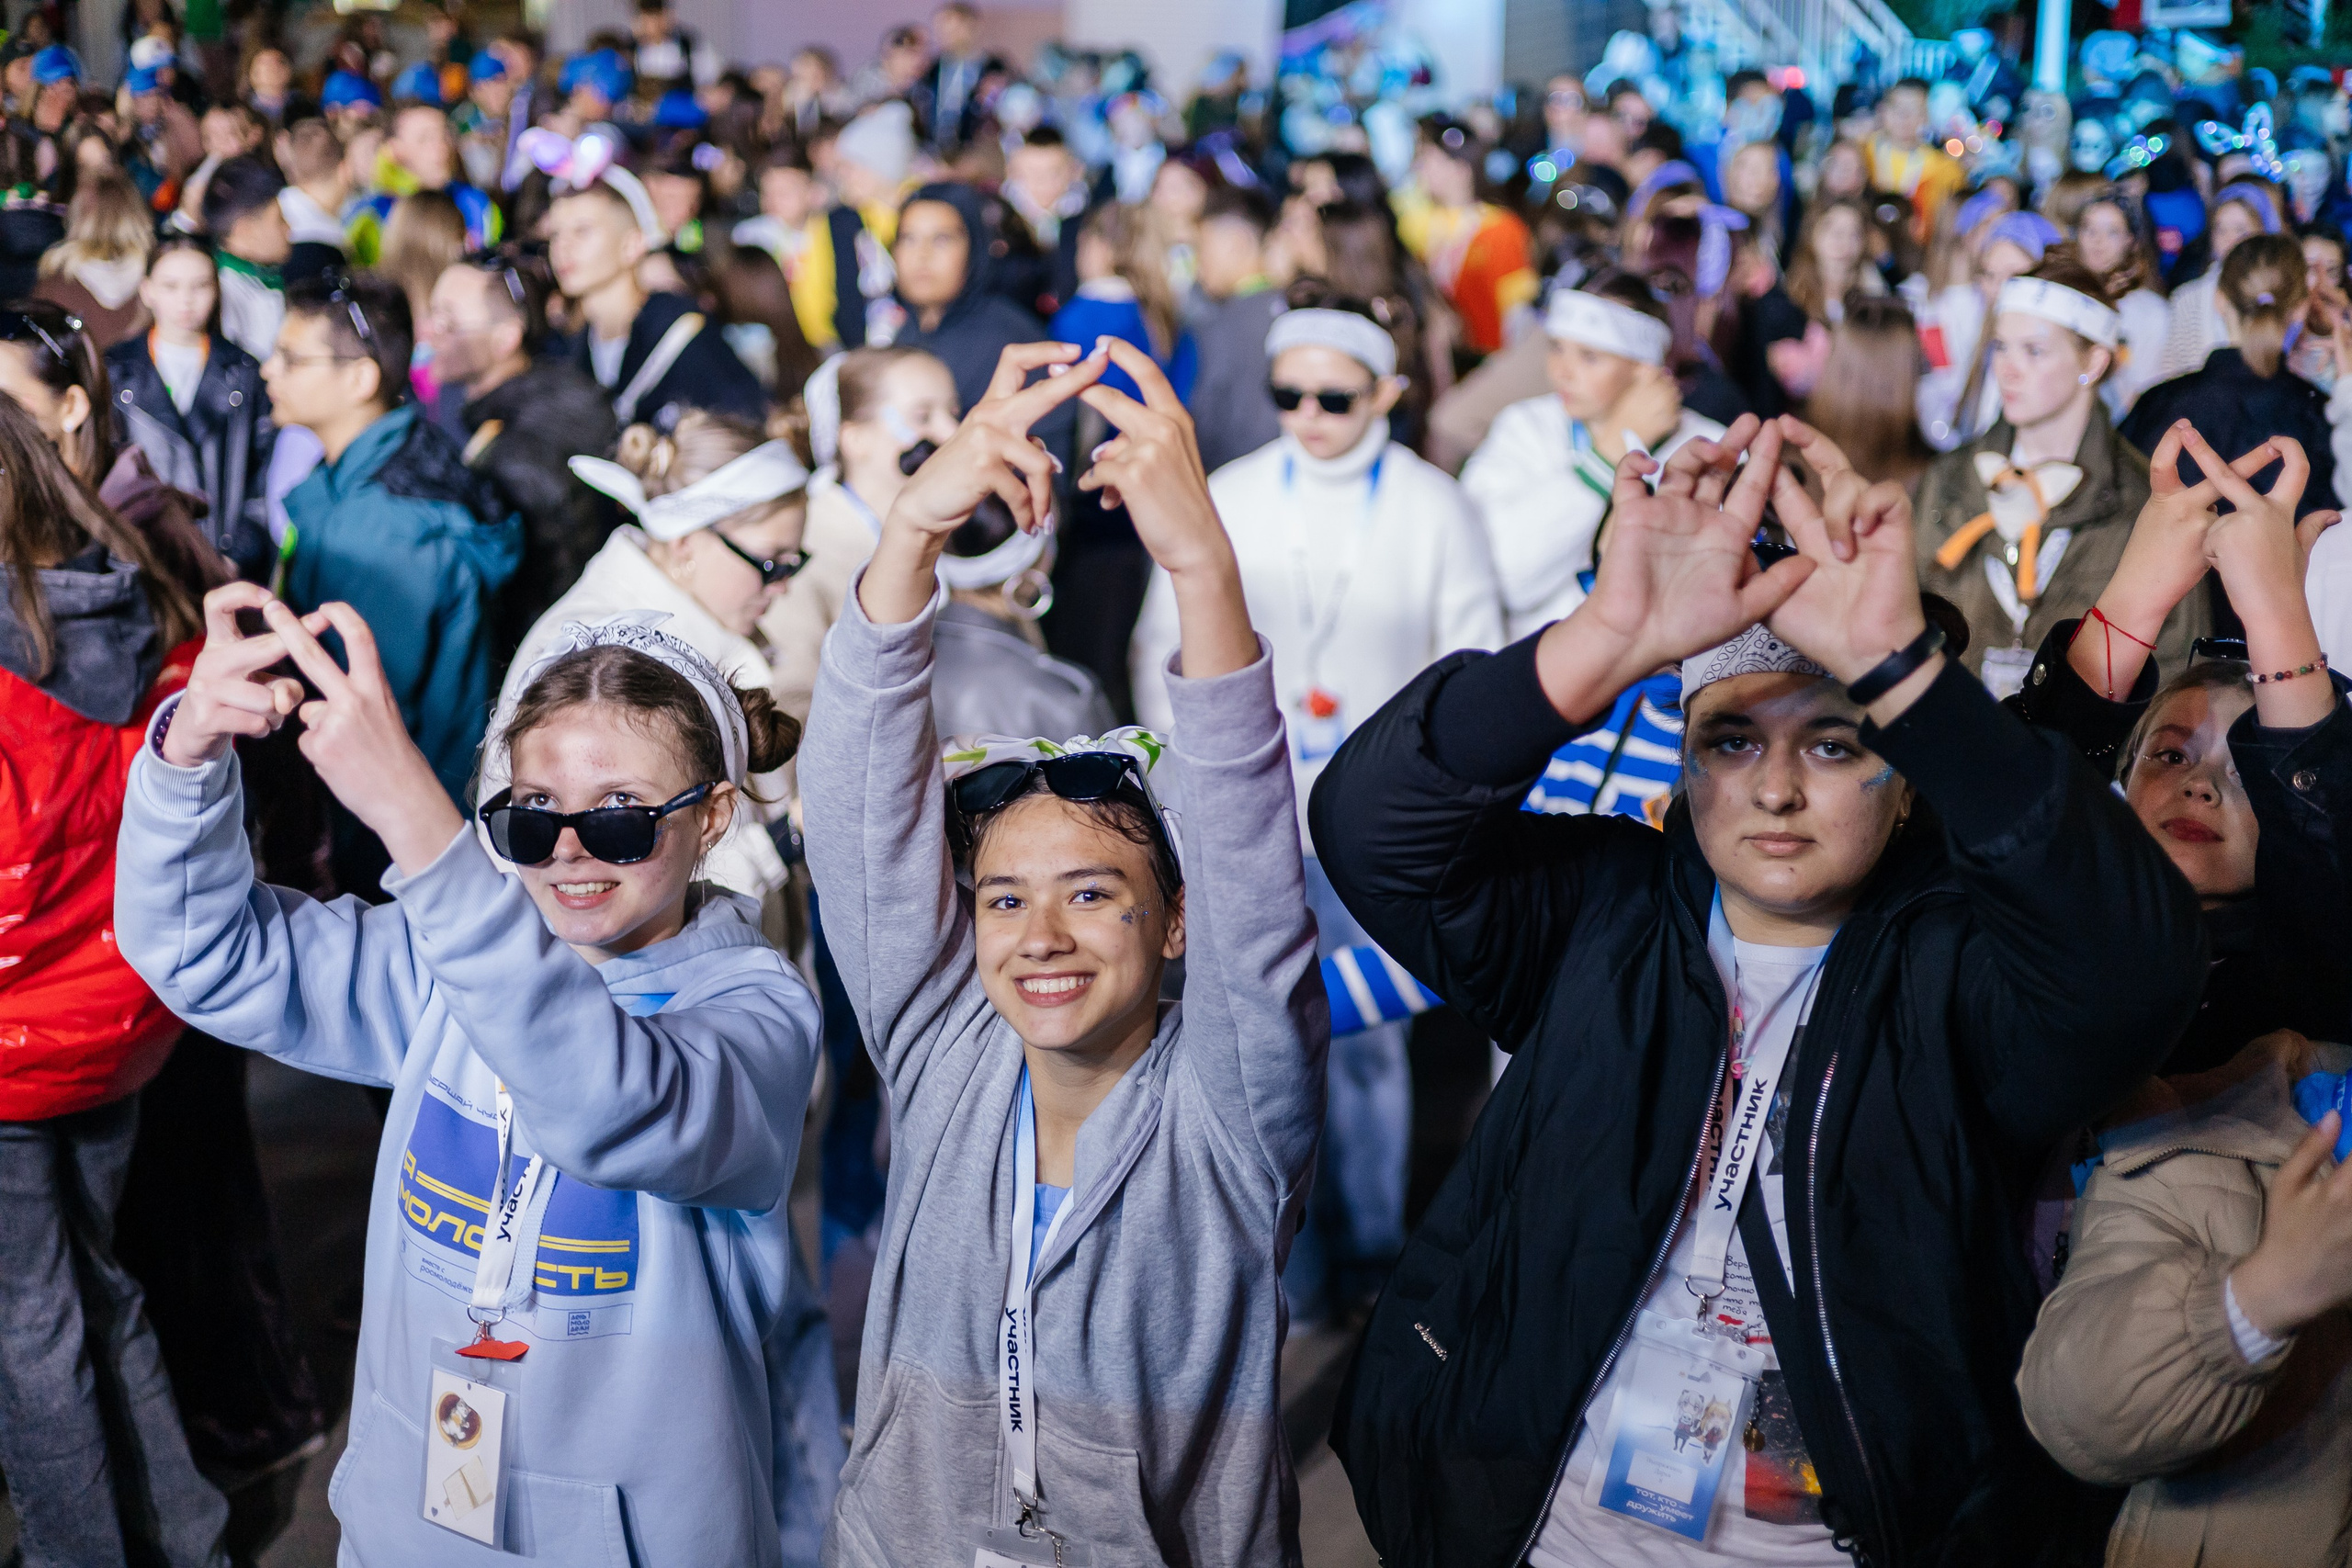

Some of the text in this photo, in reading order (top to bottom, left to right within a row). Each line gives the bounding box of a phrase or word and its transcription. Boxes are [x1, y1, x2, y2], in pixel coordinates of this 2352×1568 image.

[496, 1163, 531, 1244] учас
[1714, 1077, 1769, 1213] участник
[1004, 1307, 1024, 1434] участник
